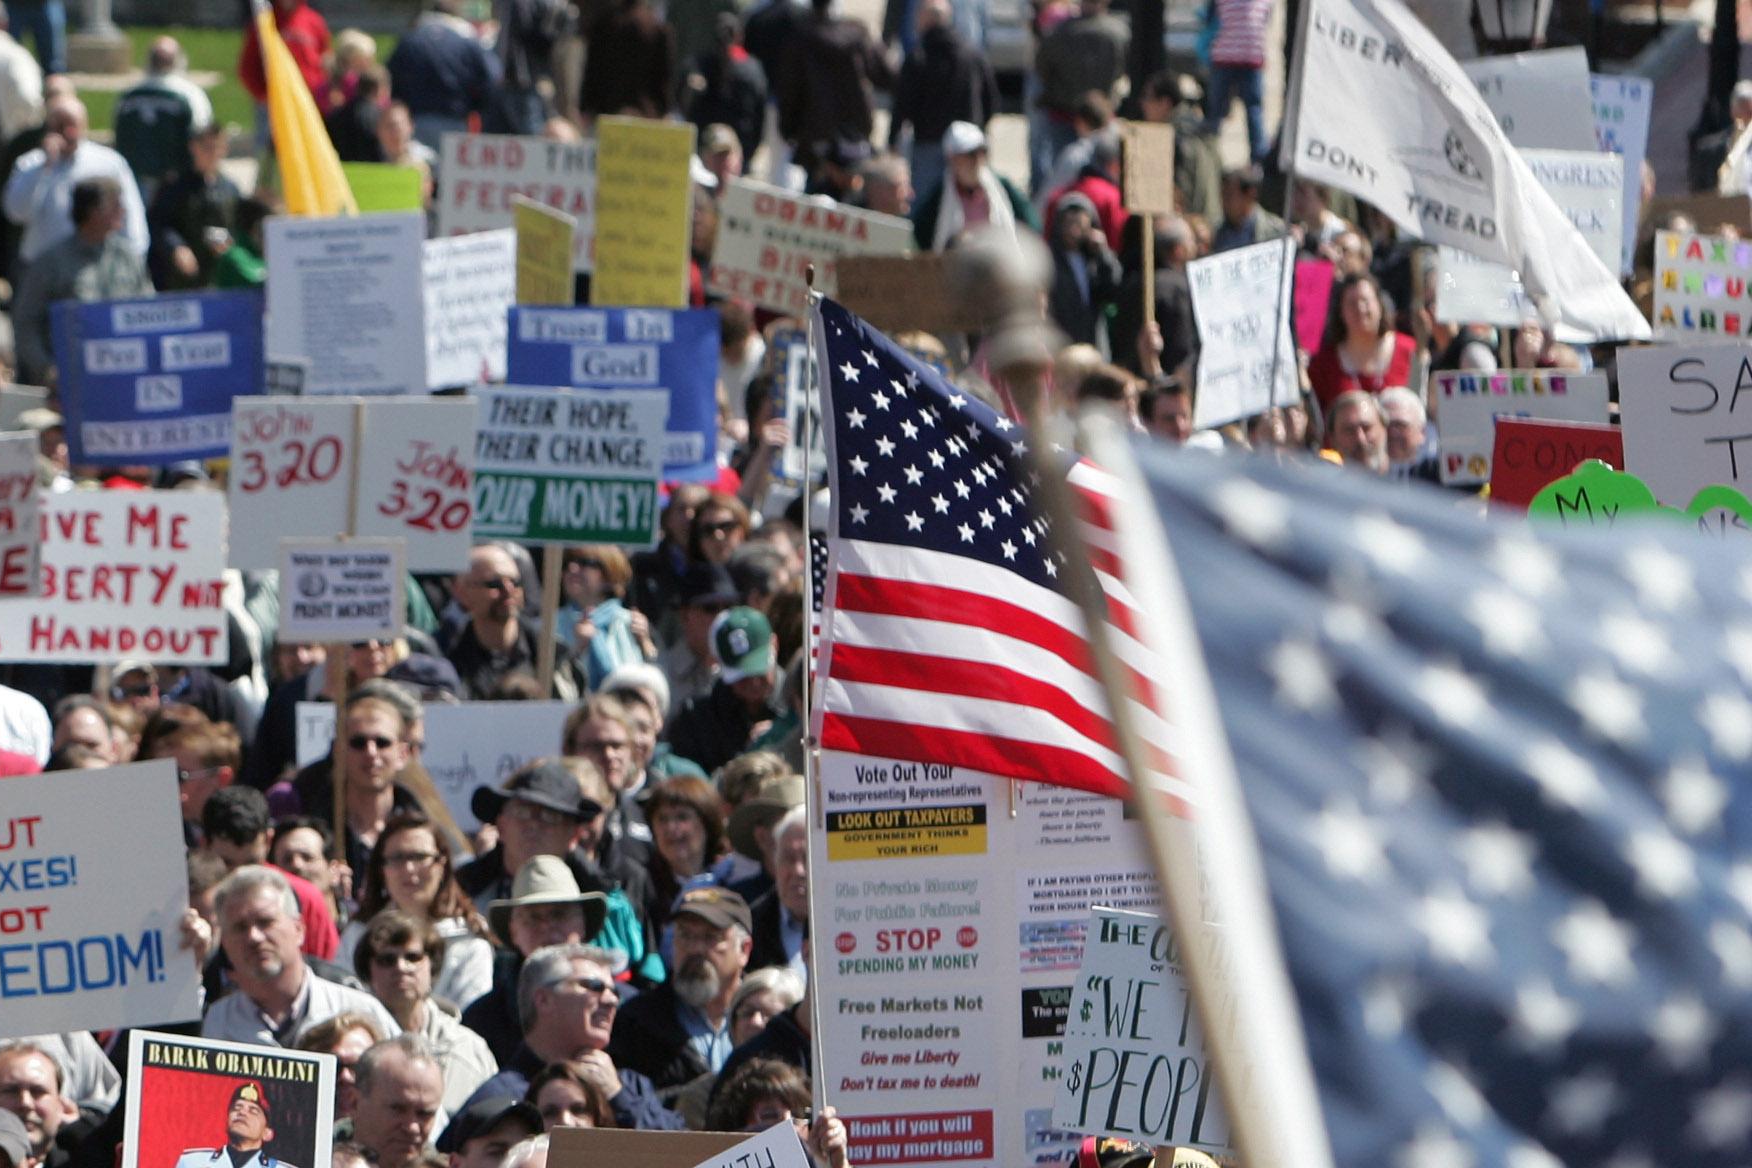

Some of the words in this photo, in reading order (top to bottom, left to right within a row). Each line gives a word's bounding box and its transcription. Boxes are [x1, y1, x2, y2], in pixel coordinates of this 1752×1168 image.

[1307, 138, 1378, 187] DONT
[753, 191, 870, 242] OBAMA
[1406, 191, 1498, 240] TREAD
[583, 351, 647, 378] God
[1440, 374, 1568, 398] TRICKLE
[489, 396, 560, 426] THEIR
[474, 431, 541, 461] THEIR
[472, 475, 538, 524] OUR
[540, 479, 654, 530] MONEY!
[126, 503, 190, 550] ME
[28, 614, 220, 657] HANDOUT
[855, 764, 888, 785] Vote
[892, 763, 918, 783] Out
[922, 762, 954, 781] Your
[908, 784, 983, 802] Representatives
[837, 813, 873, 830] LOOK
[874, 811, 902, 828] OUT
[904, 807, 975, 826] TAXPAYERS
[843, 831, 923, 843] GOVERNMENT
[927, 829, 969, 839] THINKS
[876, 846, 908, 856] YOUR
[911, 844, 939, 854] RICH
[1058, 874, 1092, 886] PAYING
[1093, 873, 1125, 885] OTHER
[875, 927, 942, 953] STOP
[1098, 916, 1149, 946] THE
[837, 957, 905, 975] SPENDING
[907, 956, 929, 971] MY
[931, 953, 980, 970] MONEY
[838, 998, 876, 1014] Free
[880, 995, 949, 1013] Markets
[953, 994, 984, 1011] Not
[860, 1023, 961, 1040] Freeloaders
[148, 1042, 210, 1071] BARAK
[214, 1051, 317, 1084] OBAMALINI
[860, 1051, 889, 1066] Give
[891, 1053, 912, 1064] me
[913, 1048, 961, 1067] Liberty
[839, 1076, 875, 1093] Don't
[876, 1077, 898, 1090] tax
[899, 1077, 921, 1089] me
[923, 1075, 938, 1089] to
[939, 1072, 982, 1089] death!
[850, 1119, 892, 1138] Honk
[908, 1119, 940, 1137] you
[942, 1114, 973, 1133] will
[876, 1142, 903, 1160] my
[903, 1138, 984, 1157] mortgage
